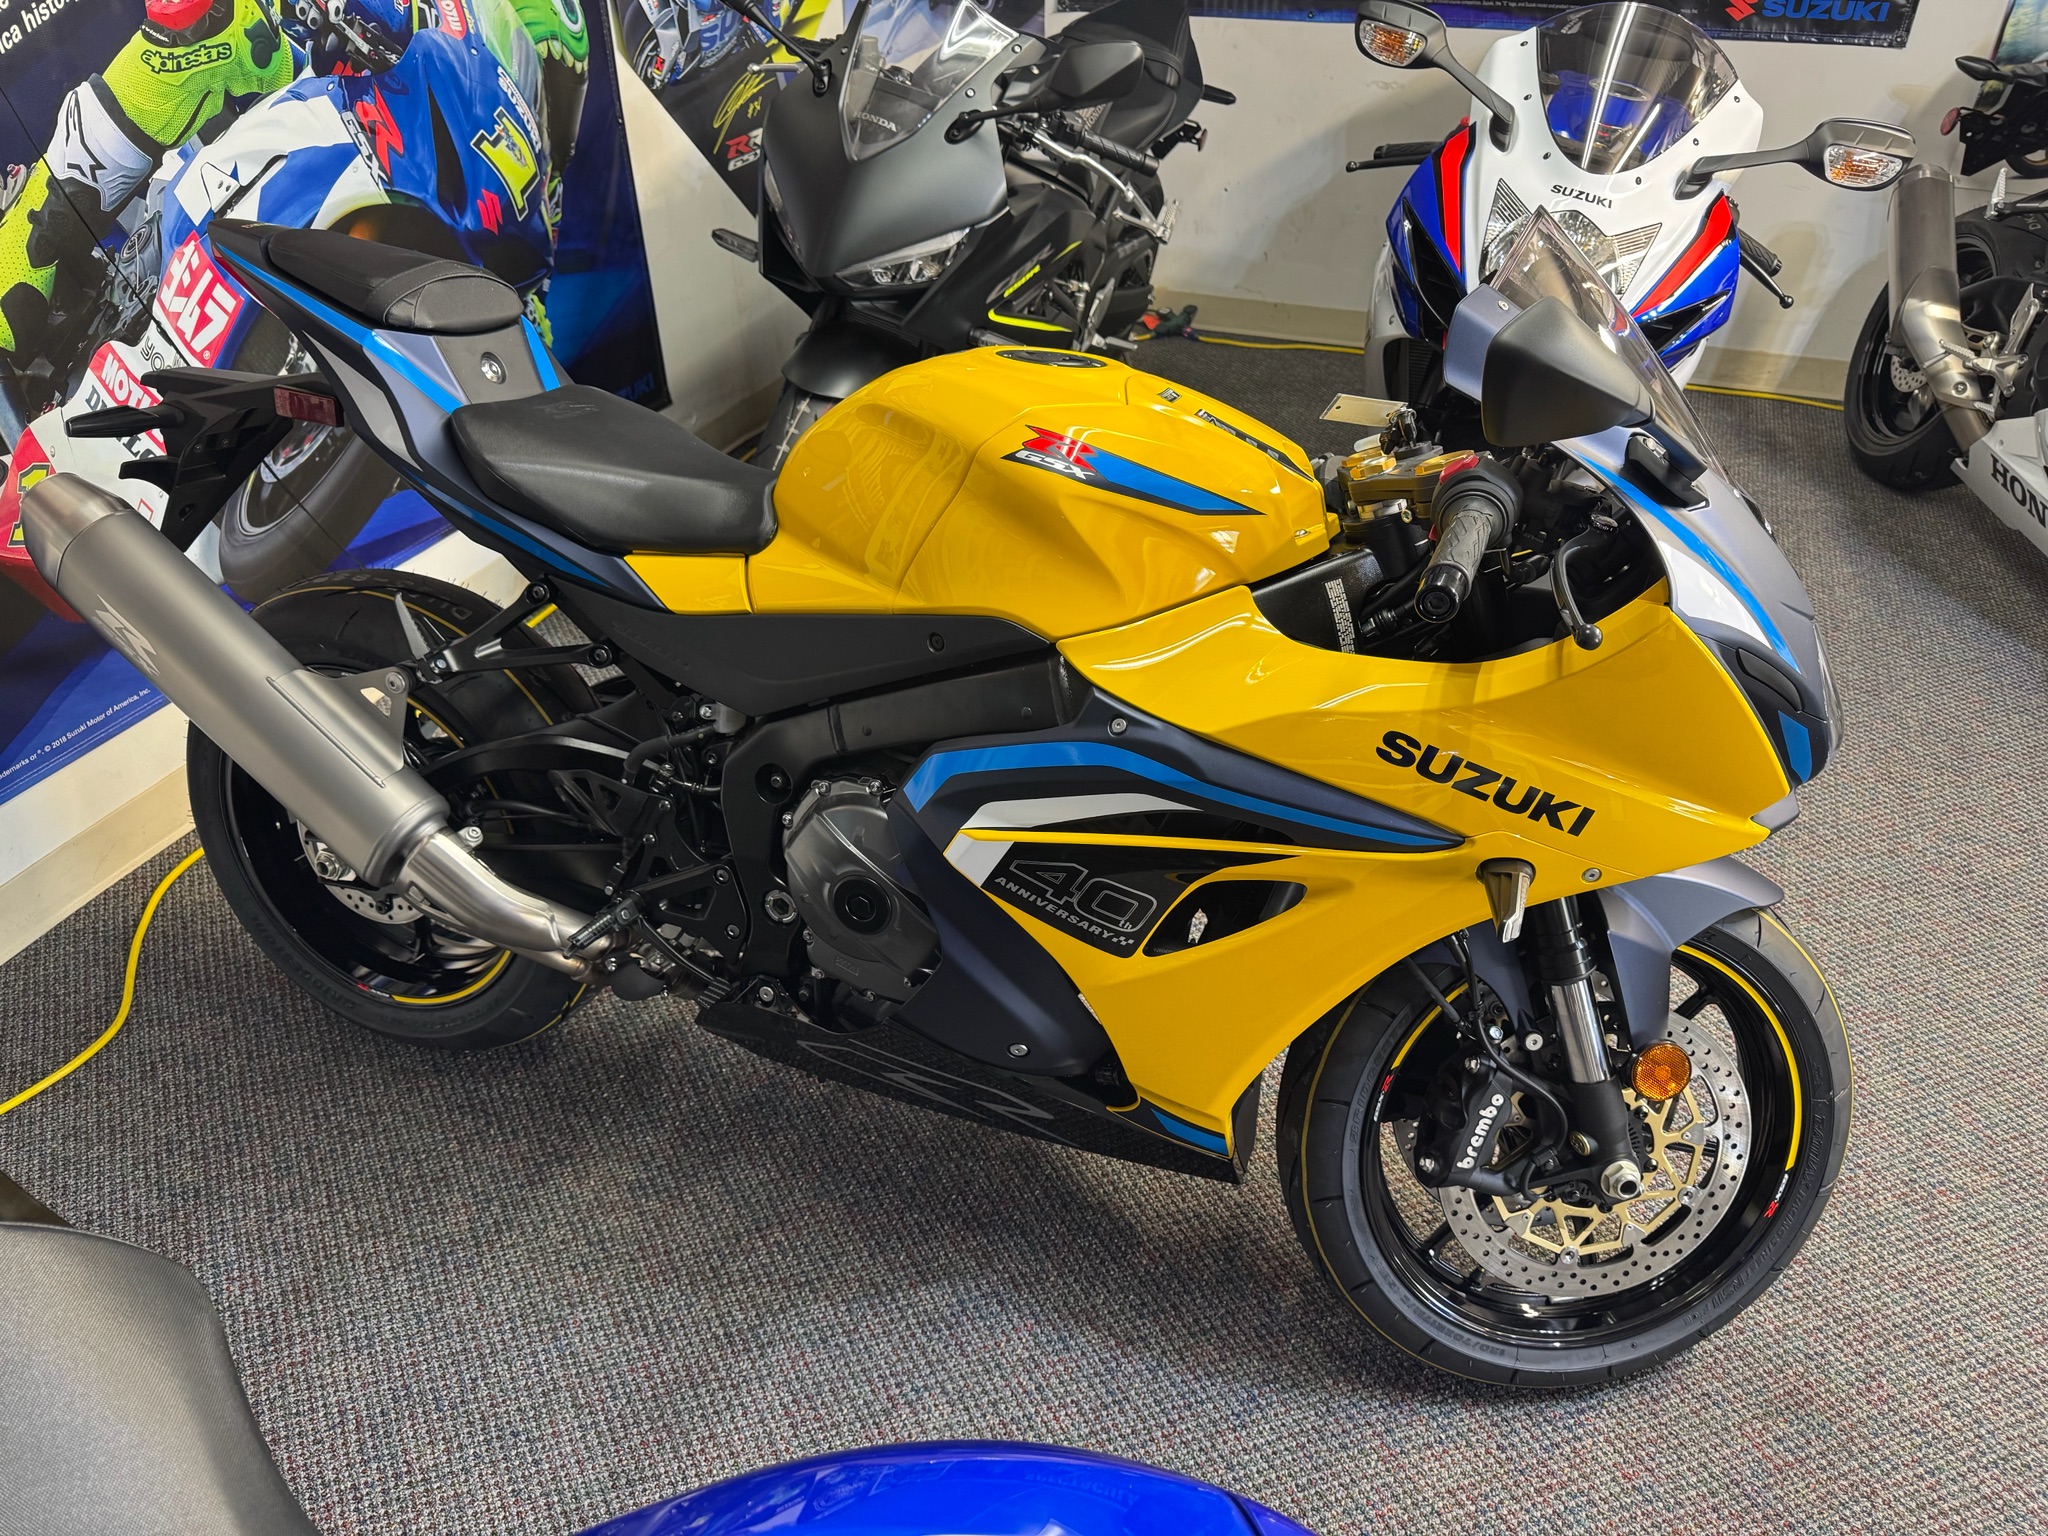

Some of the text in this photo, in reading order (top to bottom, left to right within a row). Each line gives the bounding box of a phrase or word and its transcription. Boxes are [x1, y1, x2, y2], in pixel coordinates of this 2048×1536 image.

[21, 0, 79, 33] histo
[1762, 0, 1889, 22] SUZUKI
[141, 41, 232, 74] alpinestars
[853, 110, 898, 133] HONDA
[1550, 183, 1613, 209] SUZUKI
[1014, 449, 1095, 480] GSX
[52, 736, 67, 749] 2018
[66, 723, 87, 739] Suzuki
[86, 713, 106, 727] Motor
[105, 707, 113, 716] of
[112, 695, 140, 712] America,
[1376, 730, 1596, 837] SUZUKI
[995, 877, 1115, 940] ANNIVERSARY
[1456, 1093, 1504, 1170] brembo
